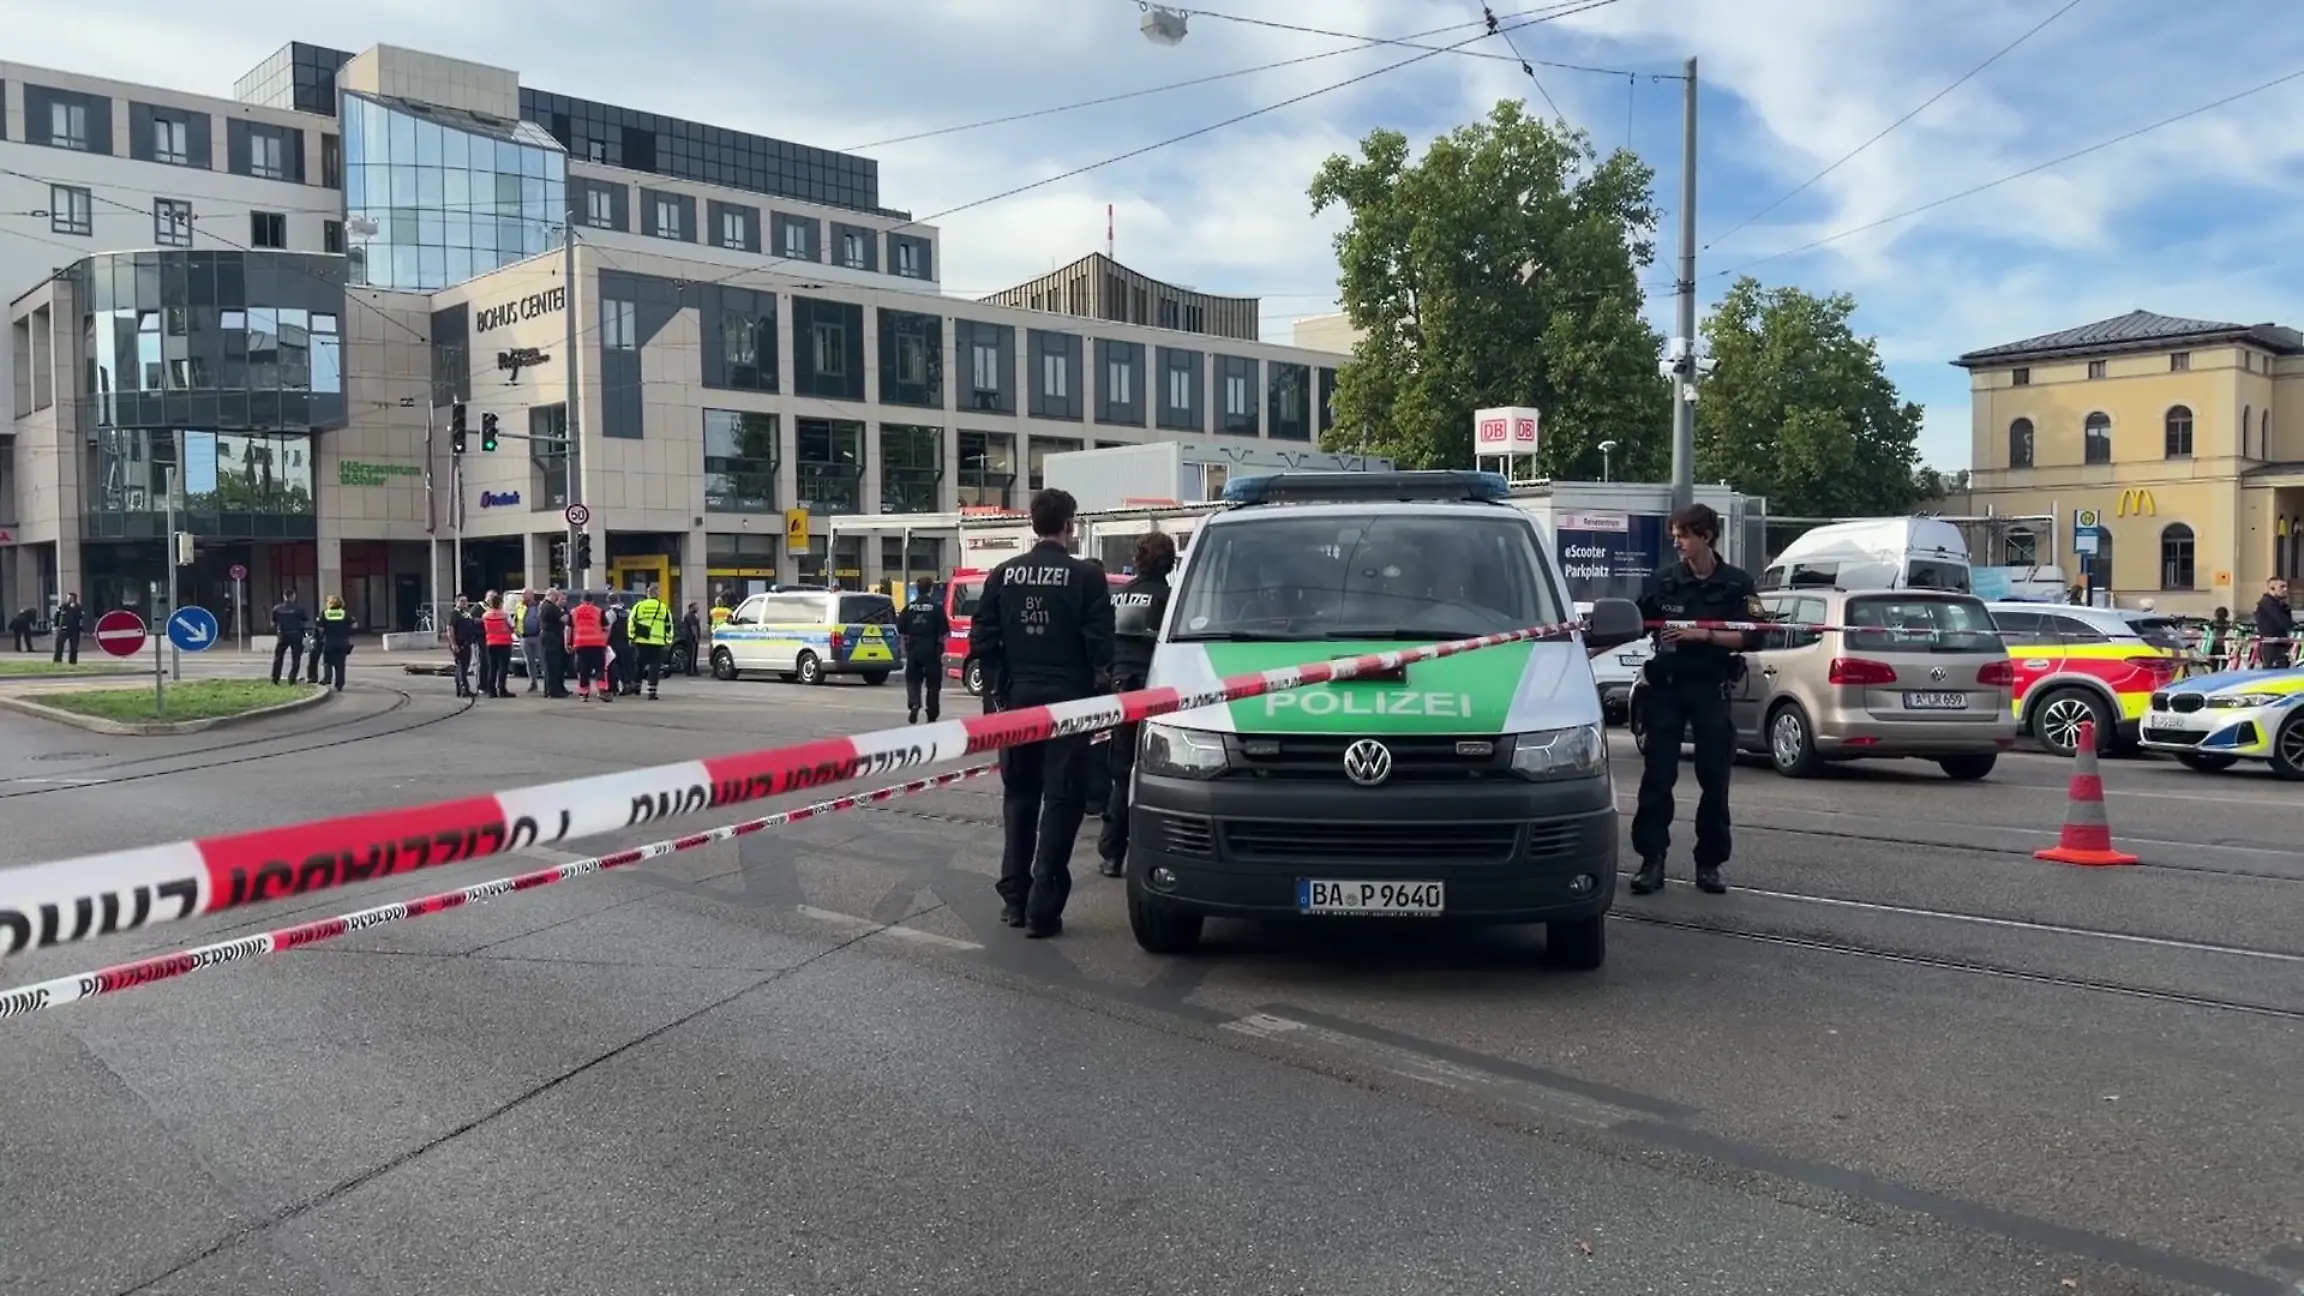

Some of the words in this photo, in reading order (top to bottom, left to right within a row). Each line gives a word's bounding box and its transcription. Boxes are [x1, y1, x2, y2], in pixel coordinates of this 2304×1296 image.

[477, 302, 518, 333] BOHUS
[1484, 423, 1504, 438] DB
[1518, 421, 1533, 438] DB
[571, 510, 585, 520] 50
[1565, 545, 1606, 558] eScooter
[1003, 566, 1070, 586] POLIZEI
[1565, 564, 1609, 580] Parkplatz
[1026, 597, 1042, 609] BY
[1021, 611, 1050, 624] 5411
[1265, 691, 1472, 717] POLIZEI
[1313, 882, 1343, 906] BA
[1361, 884, 1375, 907] P
[1381, 885, 1441, 908] 9640
